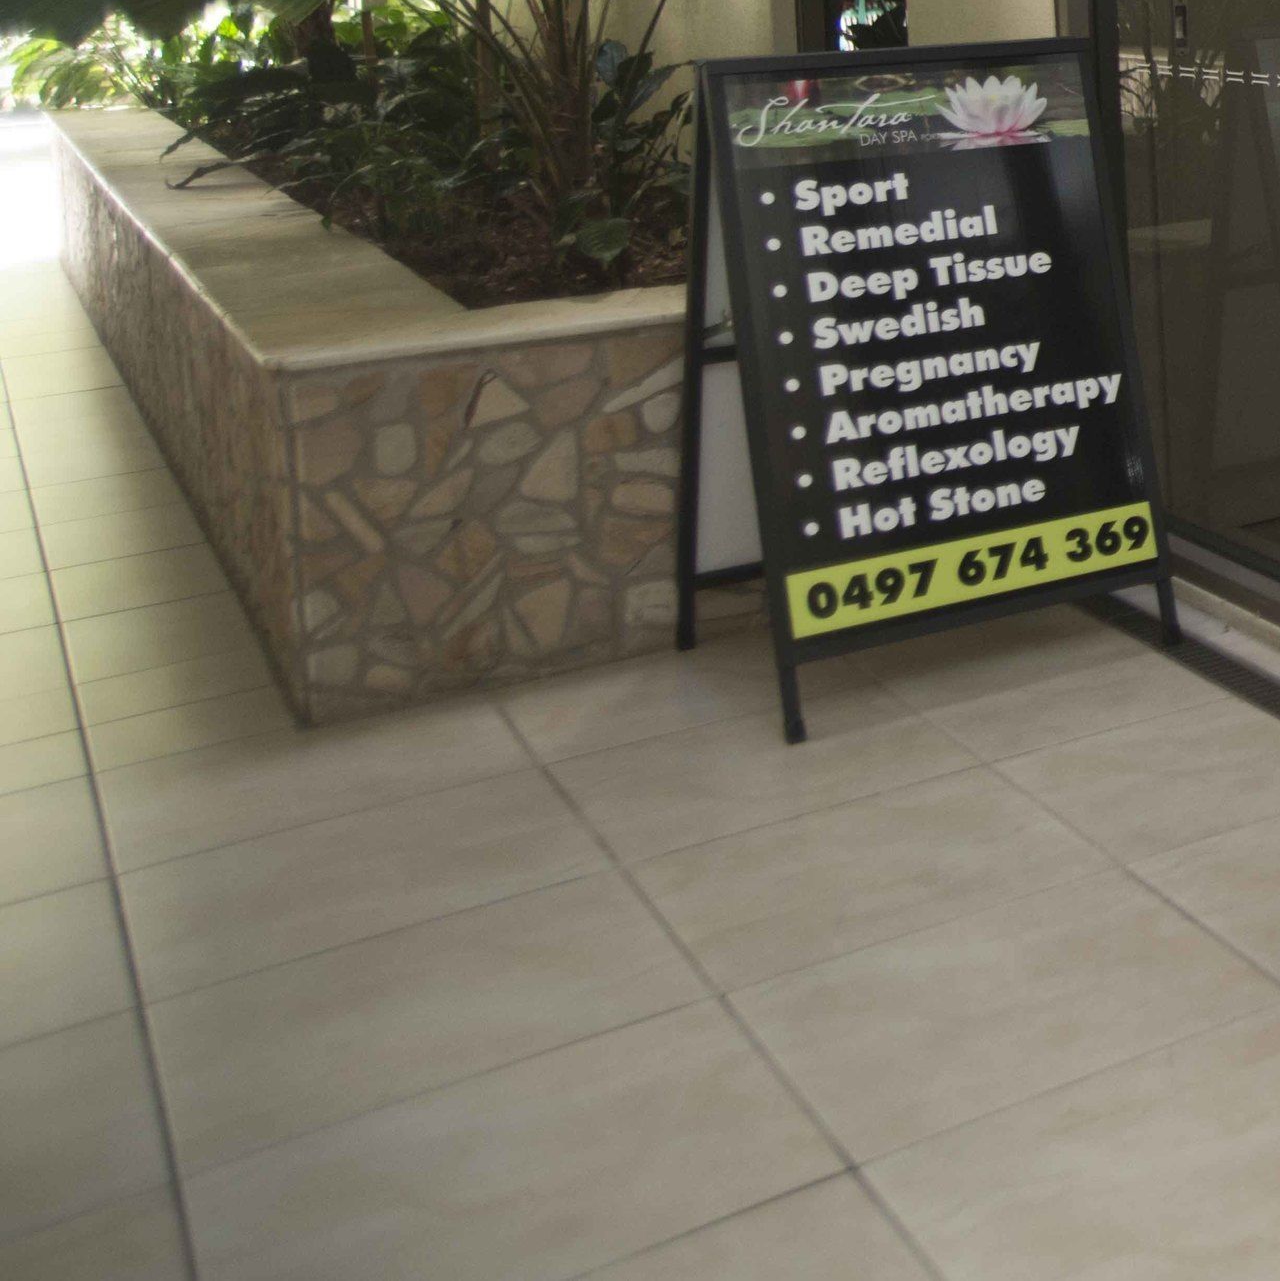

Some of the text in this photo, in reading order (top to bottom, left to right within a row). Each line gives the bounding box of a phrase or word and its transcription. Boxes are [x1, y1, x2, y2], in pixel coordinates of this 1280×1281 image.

[860, 132, 888, 147] DAY
[892, 130, 918, 144] SPA
[794, 172, 909, 216] Sport
[801, 205, 998, 257] Remedial
[807, 251, 1053, 303] Deep Tissue
[813, 297, 985, 350] Swedish
[820, 341, 1041, 397] Pregnancy
[825, 373, 1122, 444] Aromatherapy
[832, 426, 1080, 492] Reflexology
[838, 477, 1046, 539] Hot Stone
[807, 516, 1150, 619] 0497 674 369
